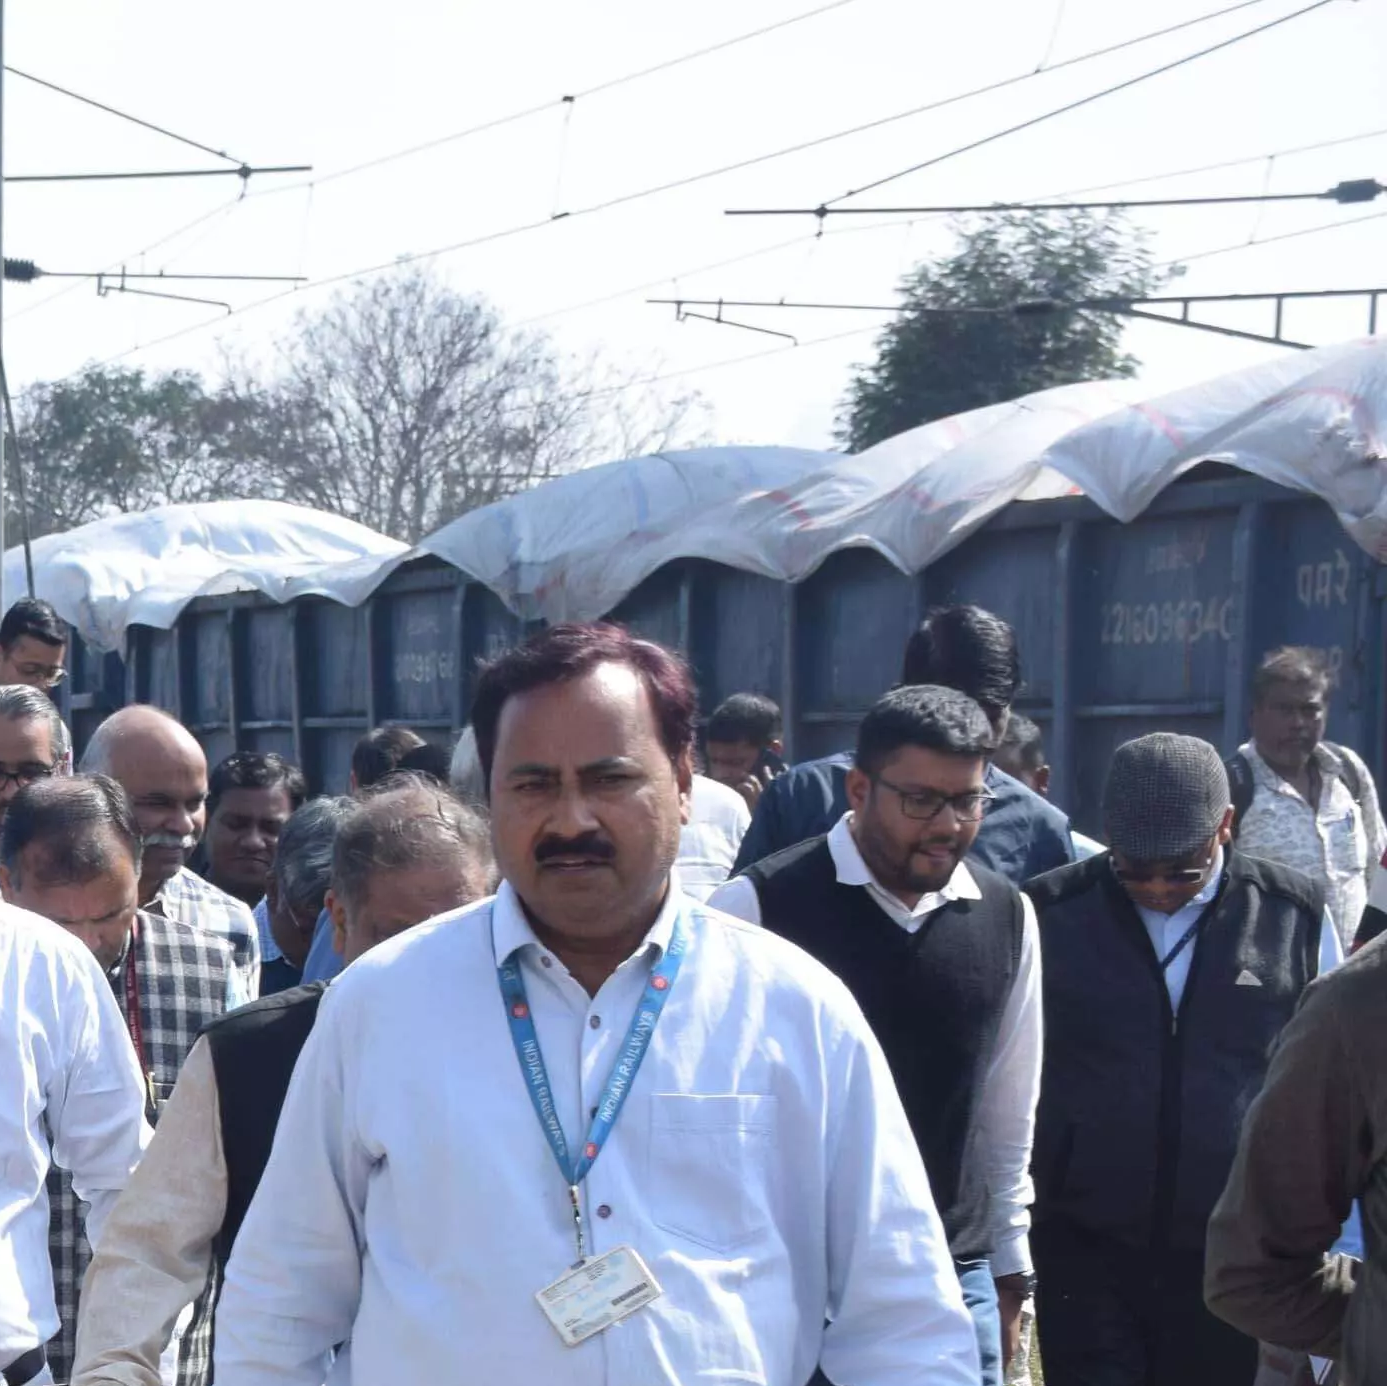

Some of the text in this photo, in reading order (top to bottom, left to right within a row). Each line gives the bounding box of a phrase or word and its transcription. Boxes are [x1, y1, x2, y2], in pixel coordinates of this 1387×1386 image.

[522, 1039, 544, 1086] INDIAN
[600, 1010, 655, 1123] INDIAN RAILWAYS
